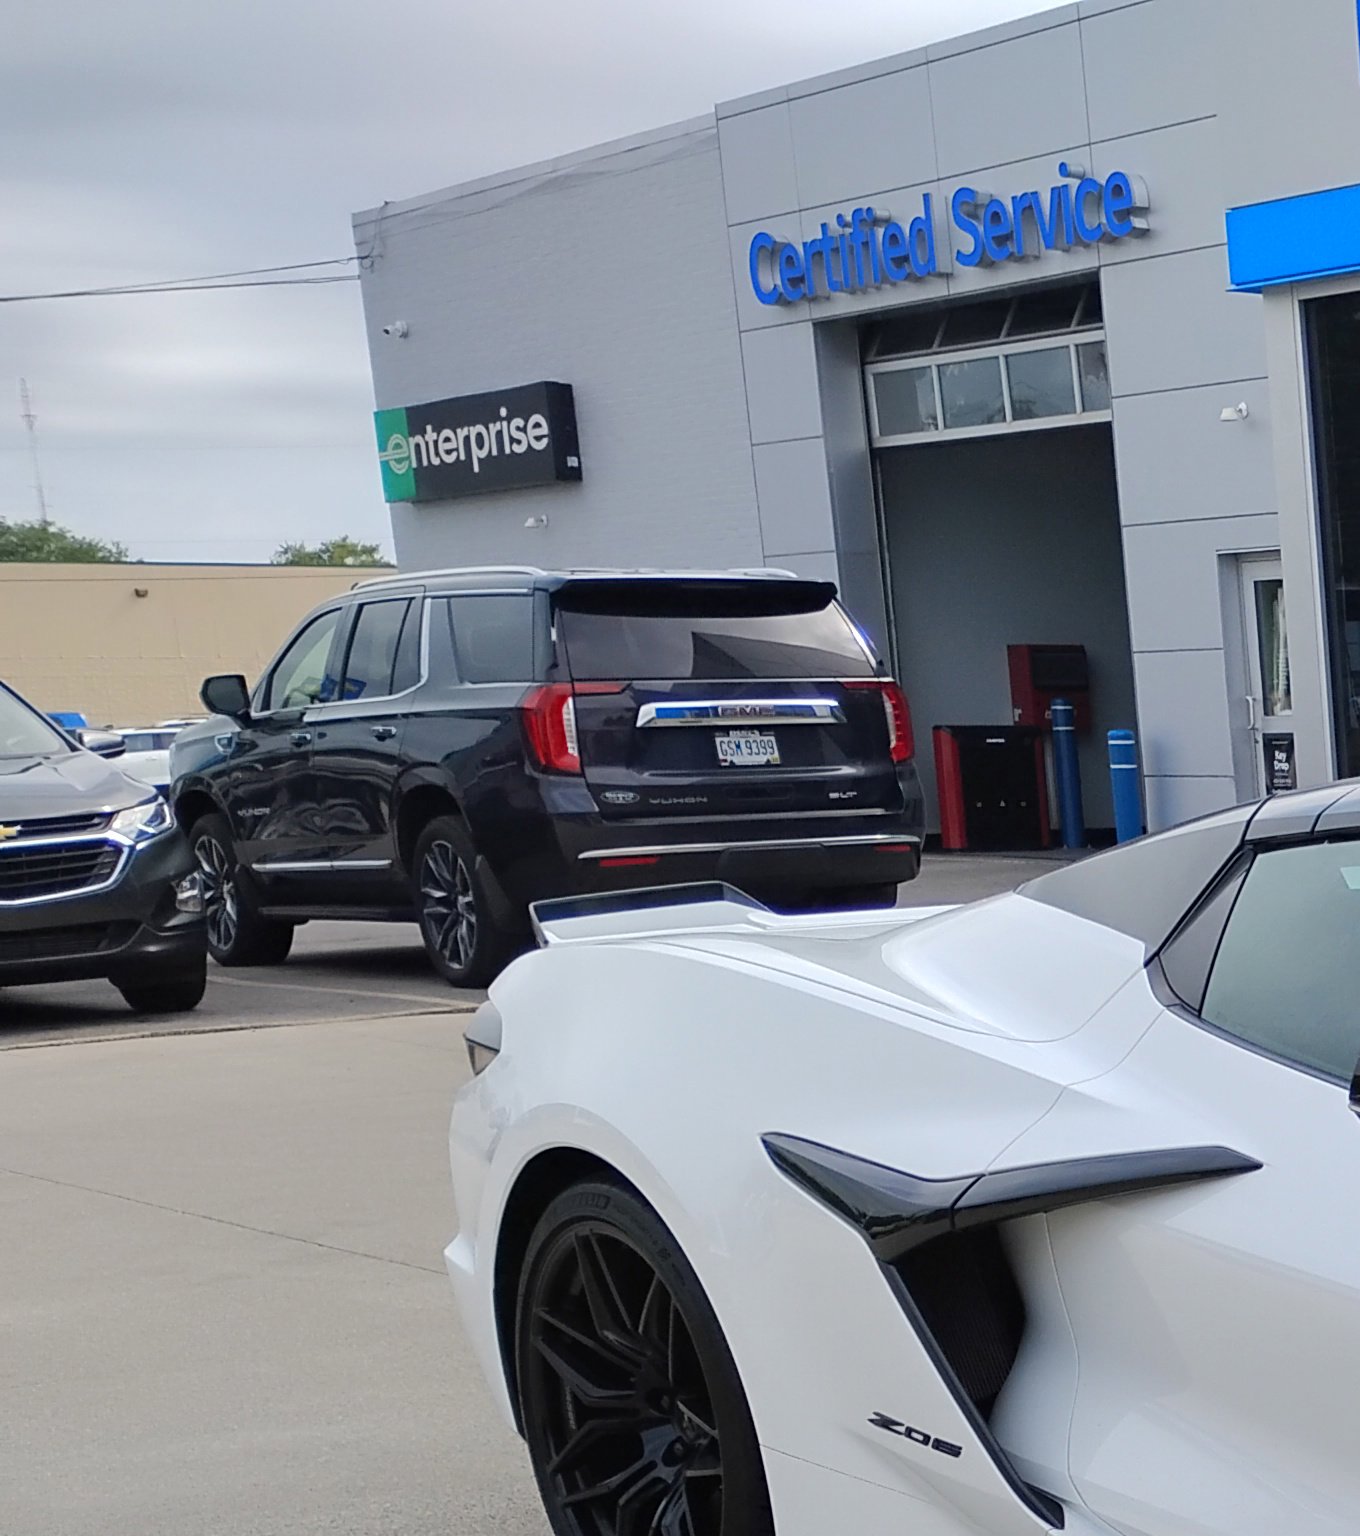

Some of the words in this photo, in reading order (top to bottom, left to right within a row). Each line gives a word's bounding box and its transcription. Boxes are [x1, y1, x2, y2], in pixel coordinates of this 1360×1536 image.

[749, 190, 940, 306] Certified
[951, 160, 1136, 268] Service
[380, 406, 550, 474] enterprise
[745, 739, 775, 756] 9399
[1274, 750, 1287, 763] Key
[867, 1411, 963, 1459] Z06
